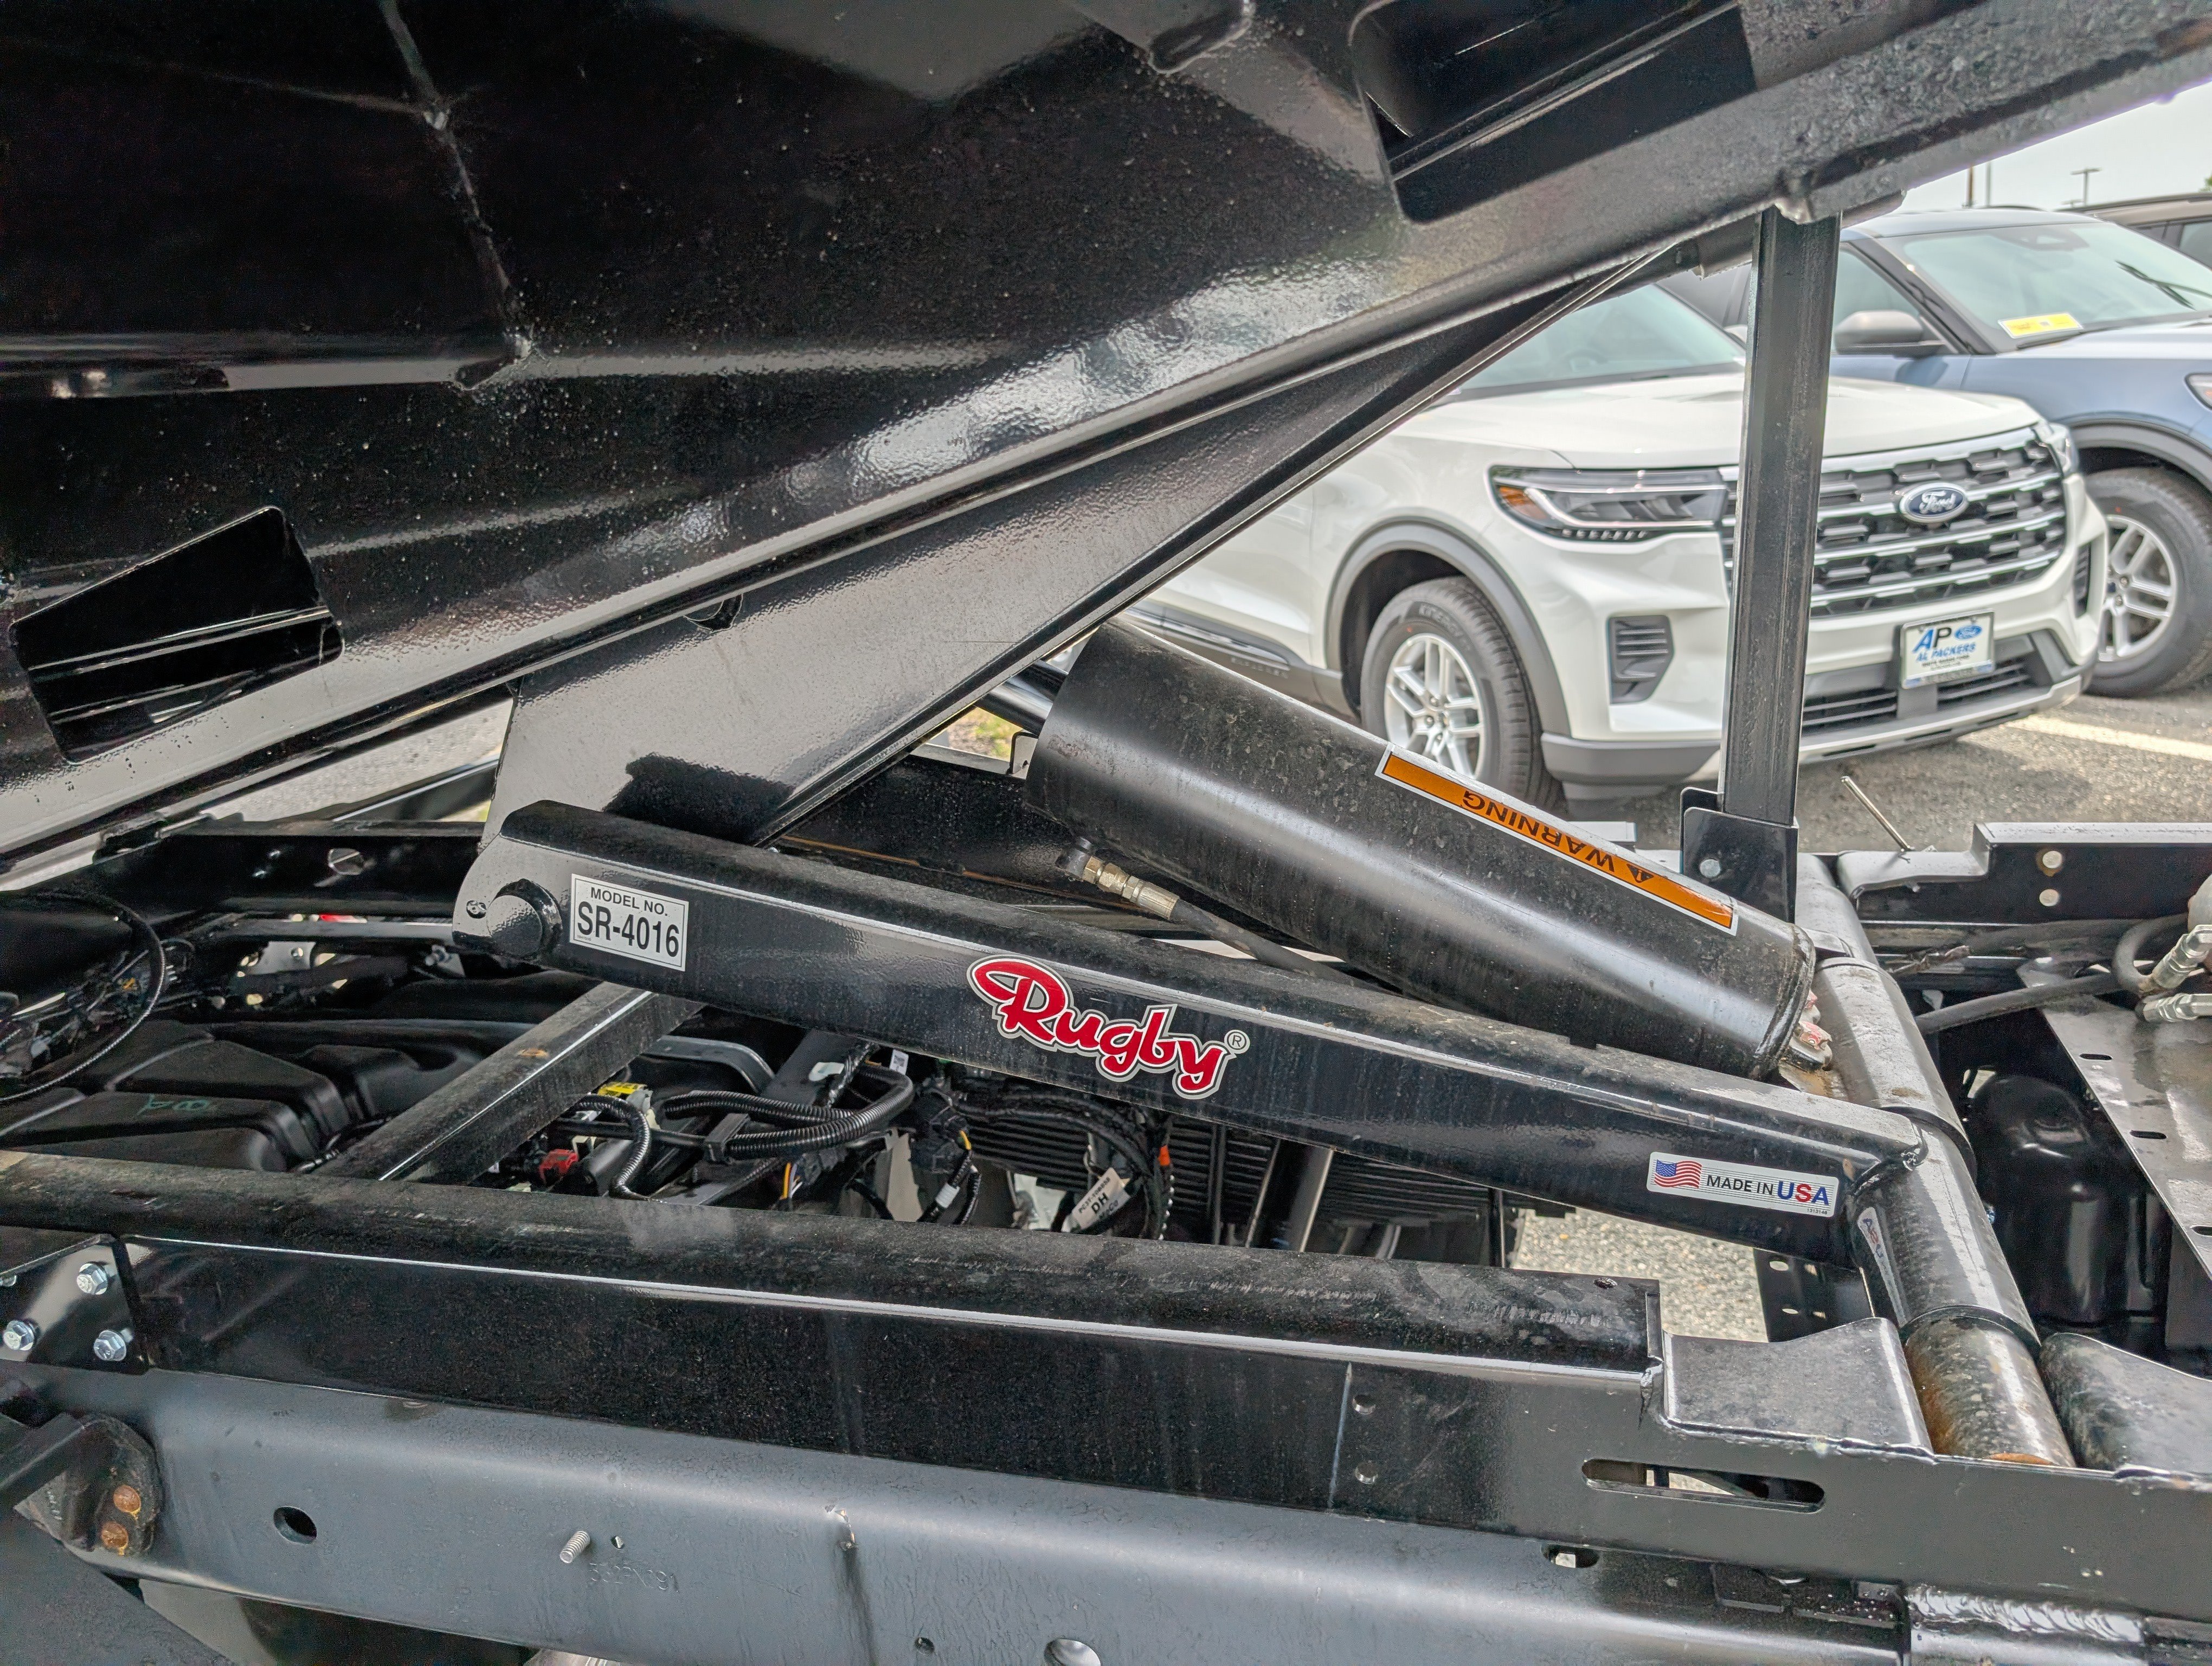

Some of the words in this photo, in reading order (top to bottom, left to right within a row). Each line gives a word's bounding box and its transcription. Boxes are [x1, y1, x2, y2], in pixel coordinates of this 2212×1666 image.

[1919, 490, 1956, 514] Ford
[1912, 627, 1952, 653] AP
[1462, 789, 1615, 873] WARNING
[590, 887, 640, 909] MODEL
[644, 900, 668, 917] NO.
[577, 901, 680, 958] SR-4016
[1091, 1192, 1109, 1214] DH
[1707, 1174, 1752, 1193] MADE
[1757, 1182, 1774, 1196] IN
[1777, 1180, 1829, 1206] USA
